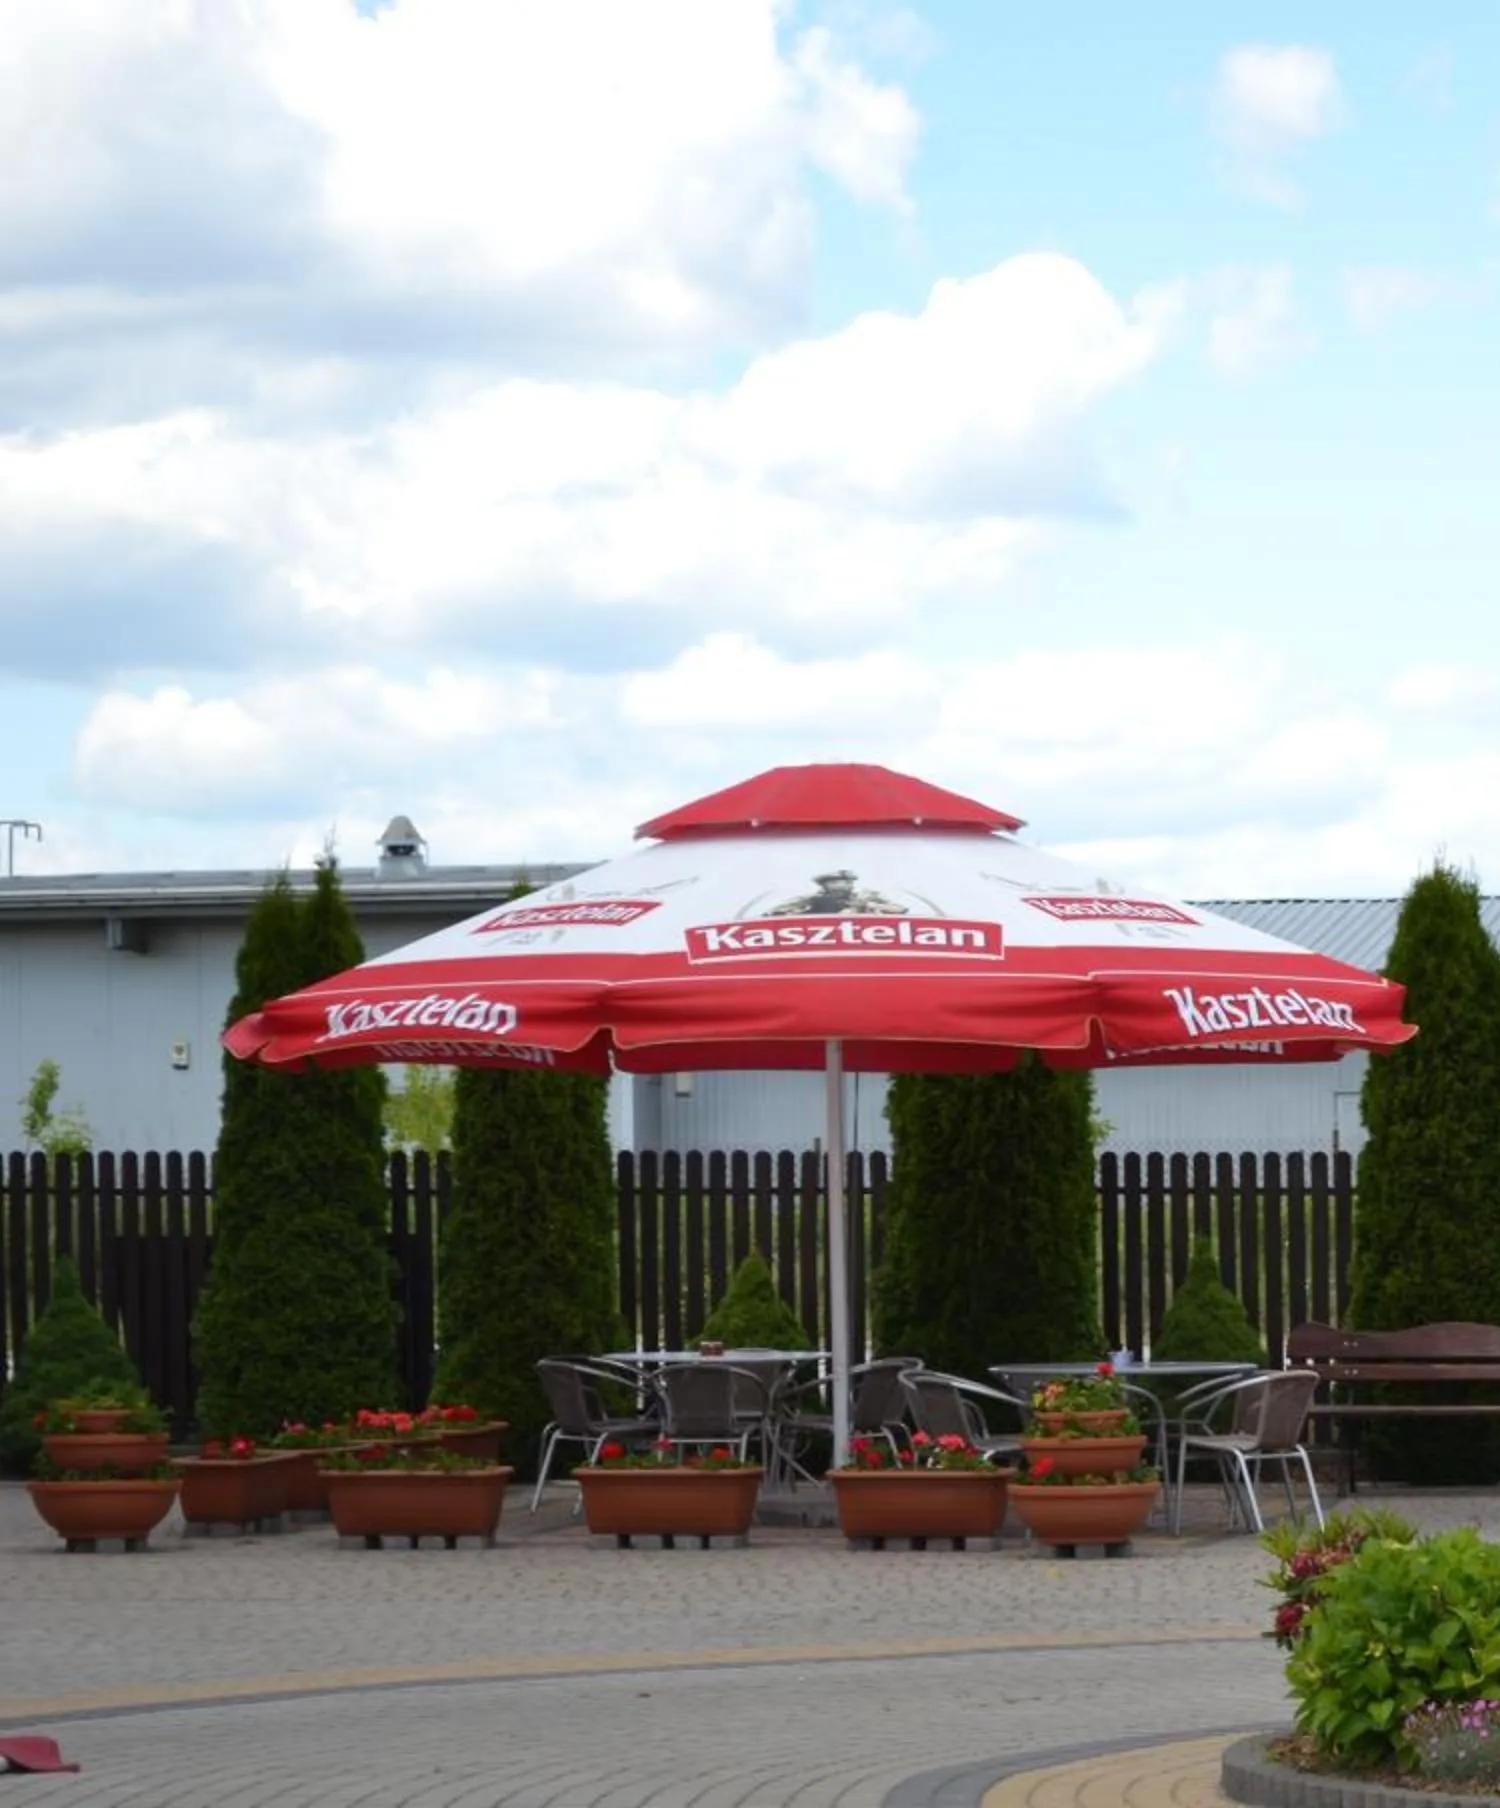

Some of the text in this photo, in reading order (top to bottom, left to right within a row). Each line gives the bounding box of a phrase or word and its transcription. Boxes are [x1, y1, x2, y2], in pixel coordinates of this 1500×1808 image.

[696, 921, 986, 951] Kasztelan
[314, 992, 518, 1043] Kasztelan
[1163, 986, 1366, 1037] Kasztelan
